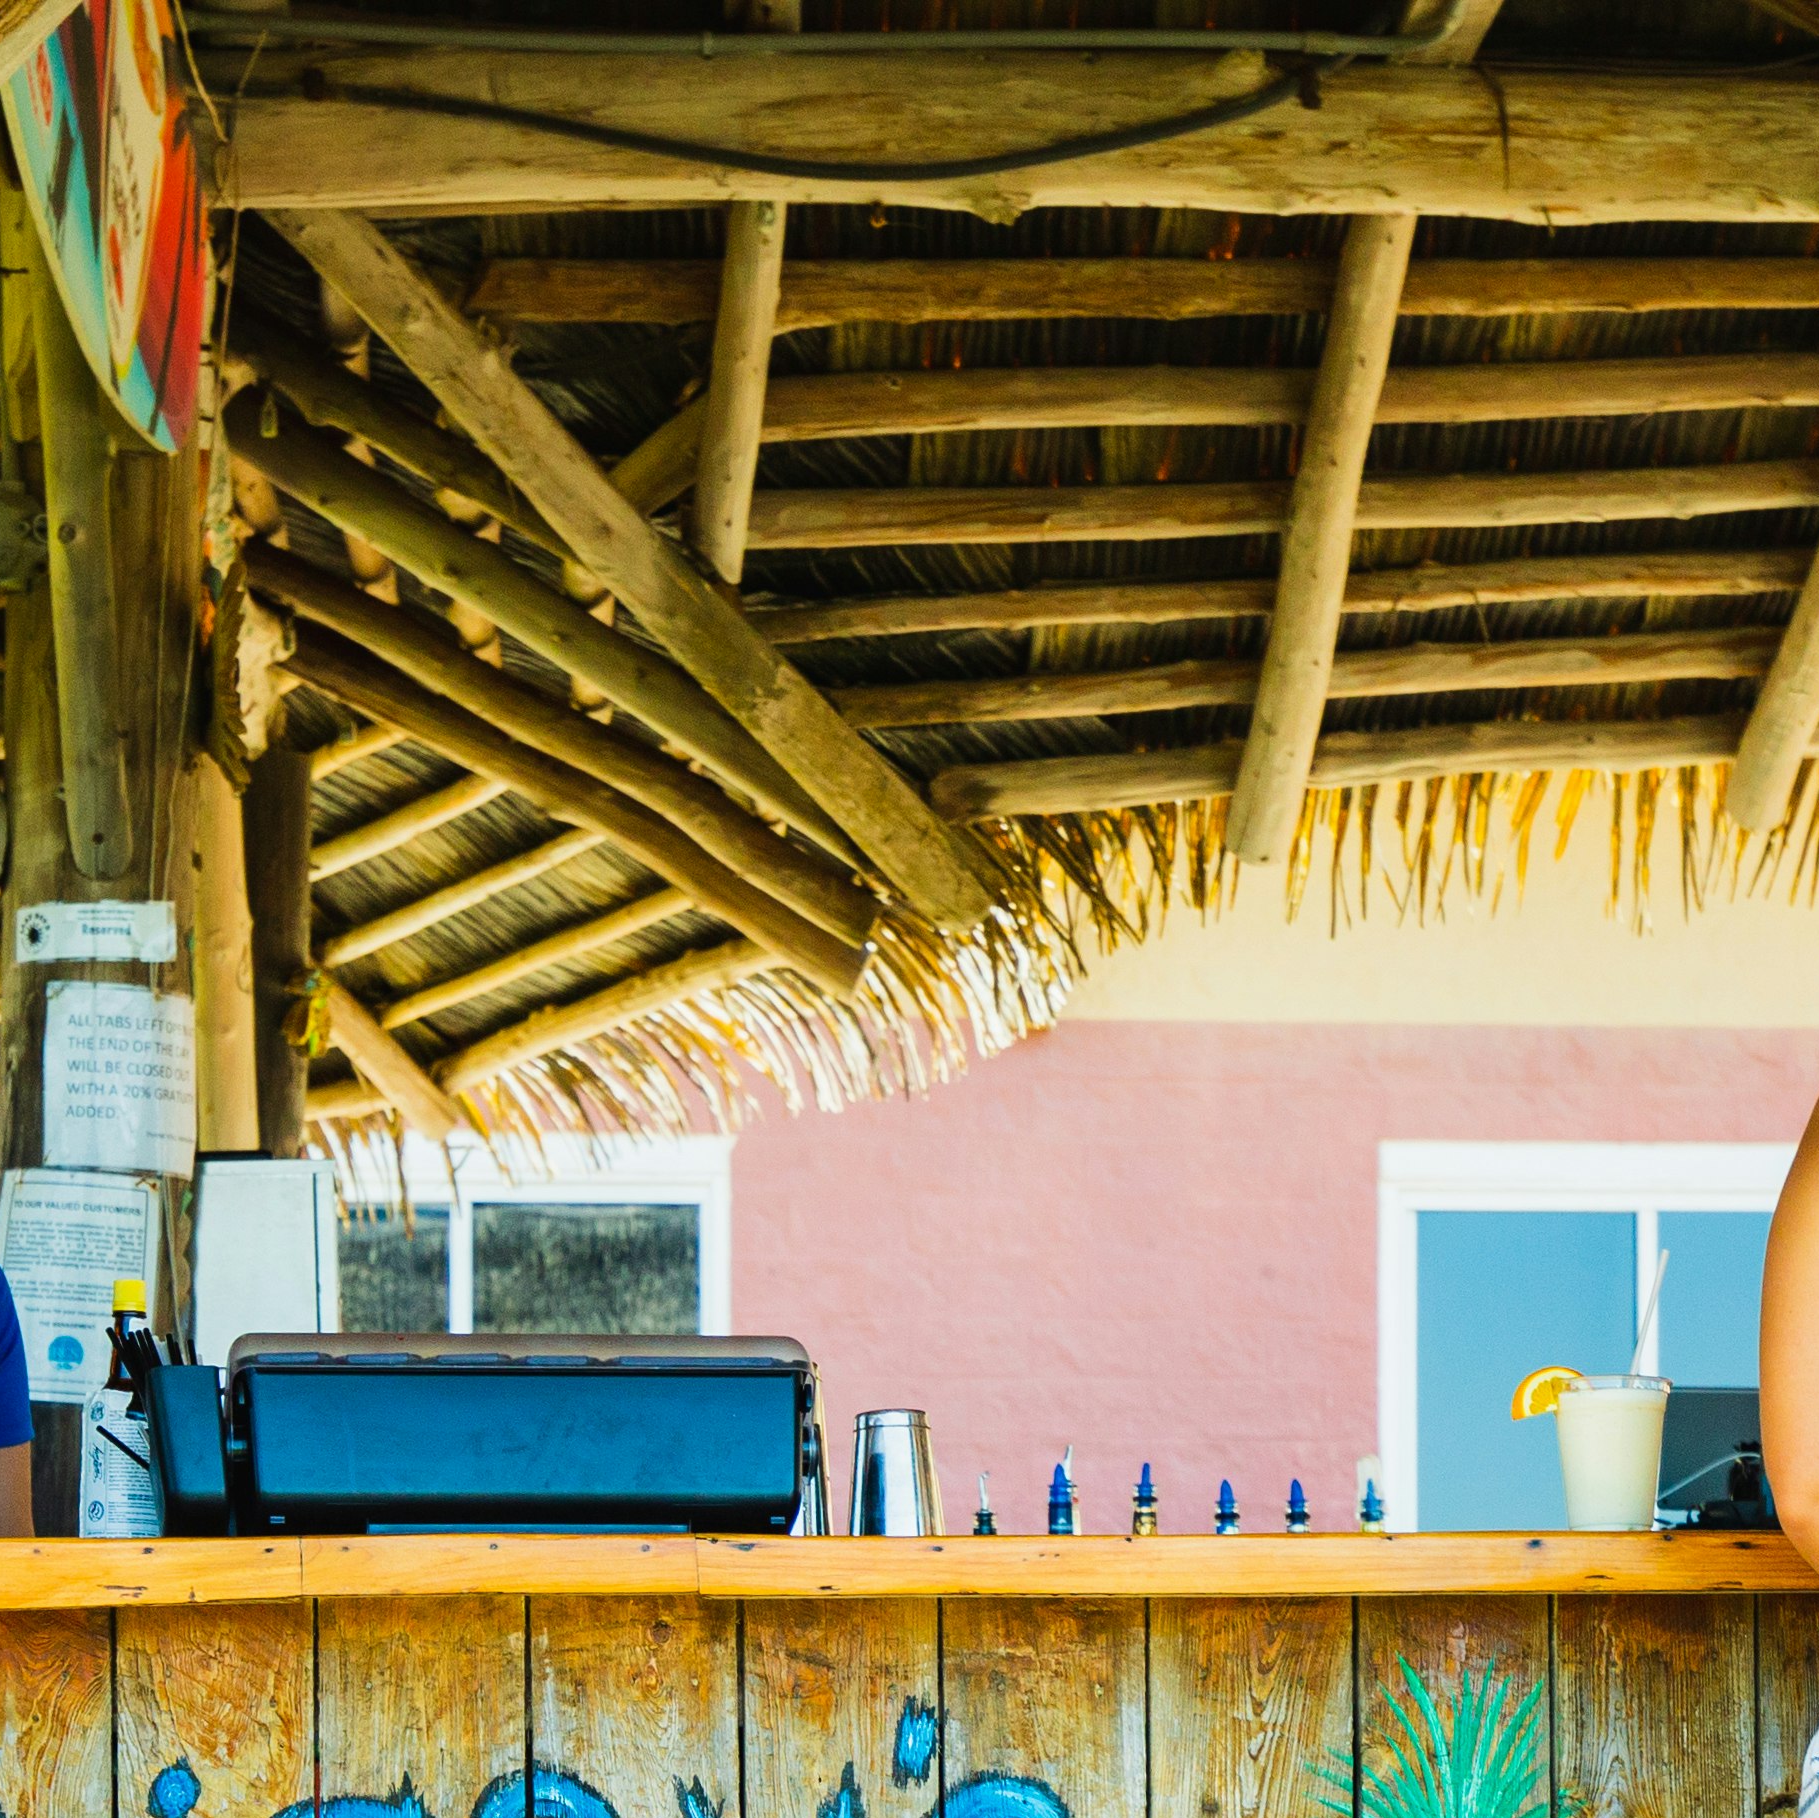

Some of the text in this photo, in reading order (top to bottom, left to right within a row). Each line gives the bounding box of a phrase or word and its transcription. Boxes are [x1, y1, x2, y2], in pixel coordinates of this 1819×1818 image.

[68, 1014, 93, 1027] ALL
[96, 1015, 132, 1029] TABS
[135, 1017, 164, 1033] LEFT
[67, 1036, 94, 1050] THE
[99, 1037, 129, 1051] END
[132, 1040, 151, 1053] OF
[155, 1042, 173, 1057] THE
[66, 1059, 101, 1073] WILL
[105, 1060, 122, 1074] BE
[126, 1062, 173, 1080] CLOSED
[65, 1082, 105, 1096] WITH
[108, 1084, 118, 1096] A
[122, 1085, 151, 1099] 20%
[24, 1201, 42, 1209] OUR
[44, 1201, 81, 1211] VALUED
